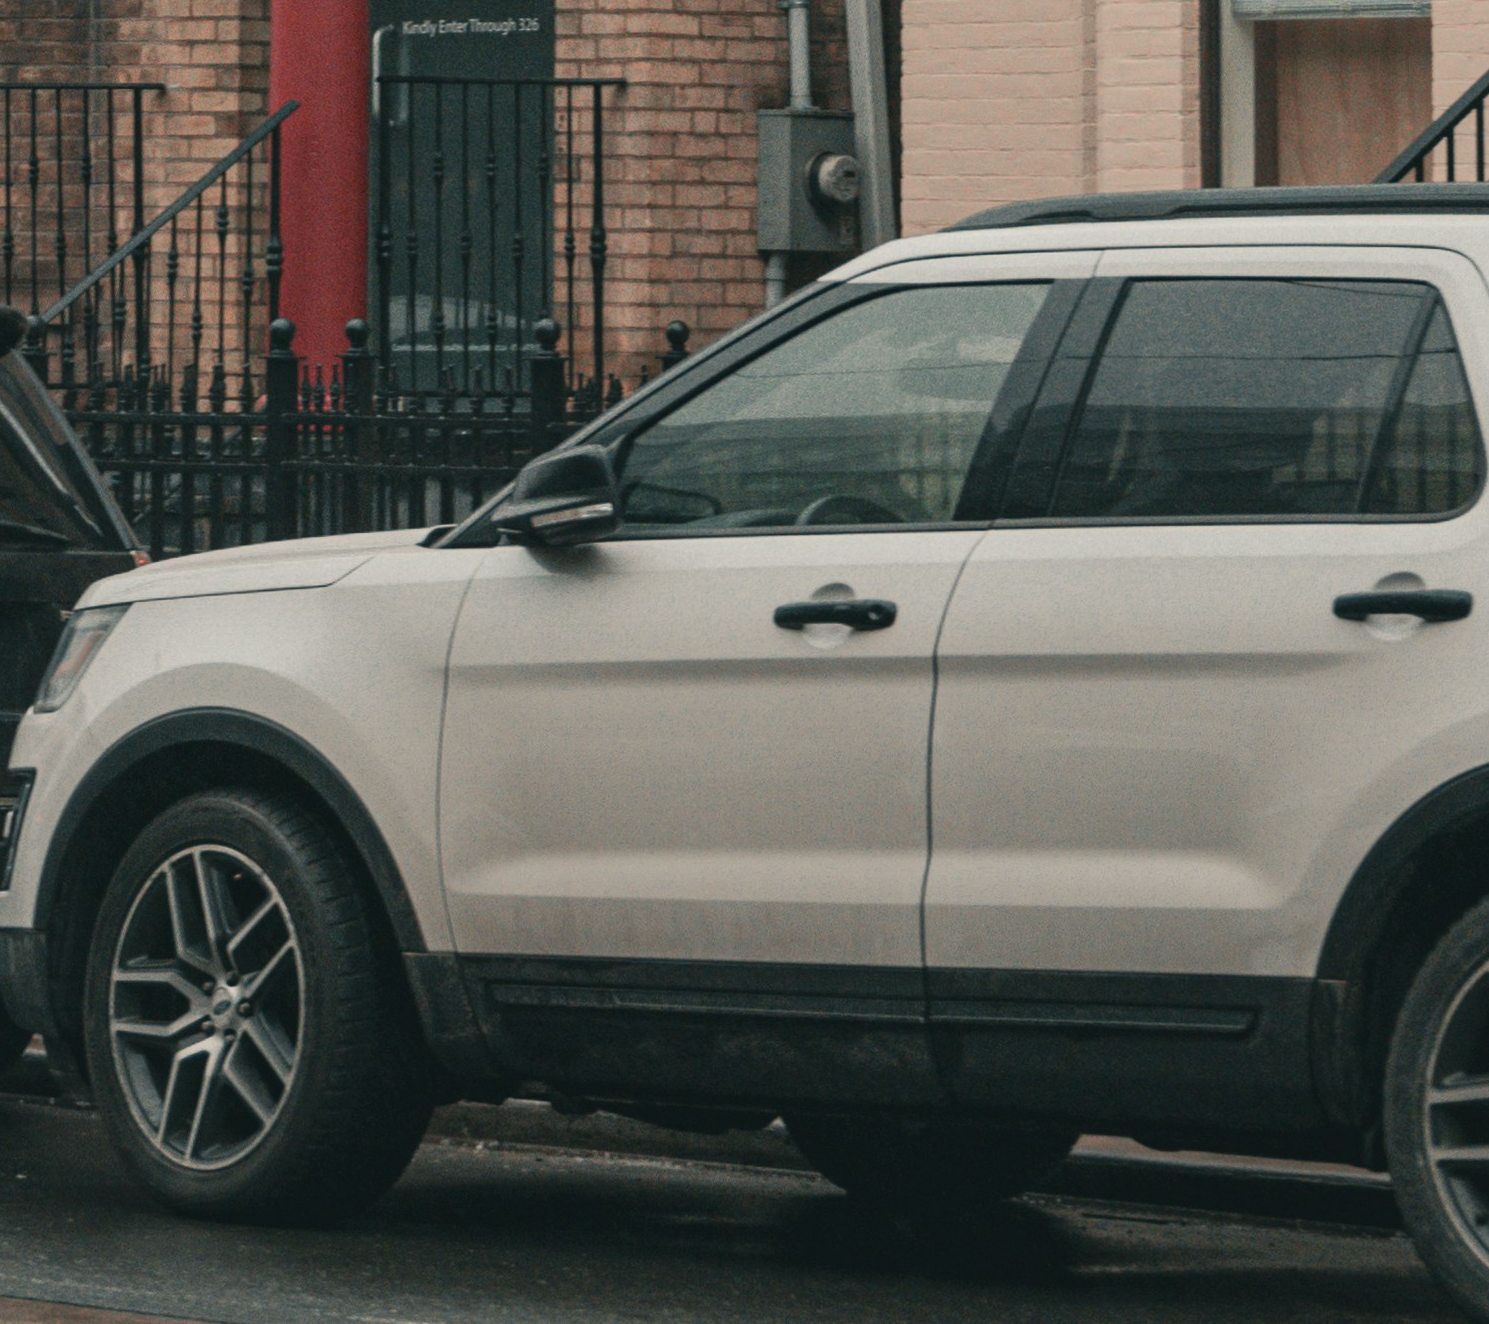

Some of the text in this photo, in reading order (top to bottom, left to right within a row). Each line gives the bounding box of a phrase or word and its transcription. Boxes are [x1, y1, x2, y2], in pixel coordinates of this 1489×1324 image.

[402, 17, 541, 37] Kindly Enter Through 326
